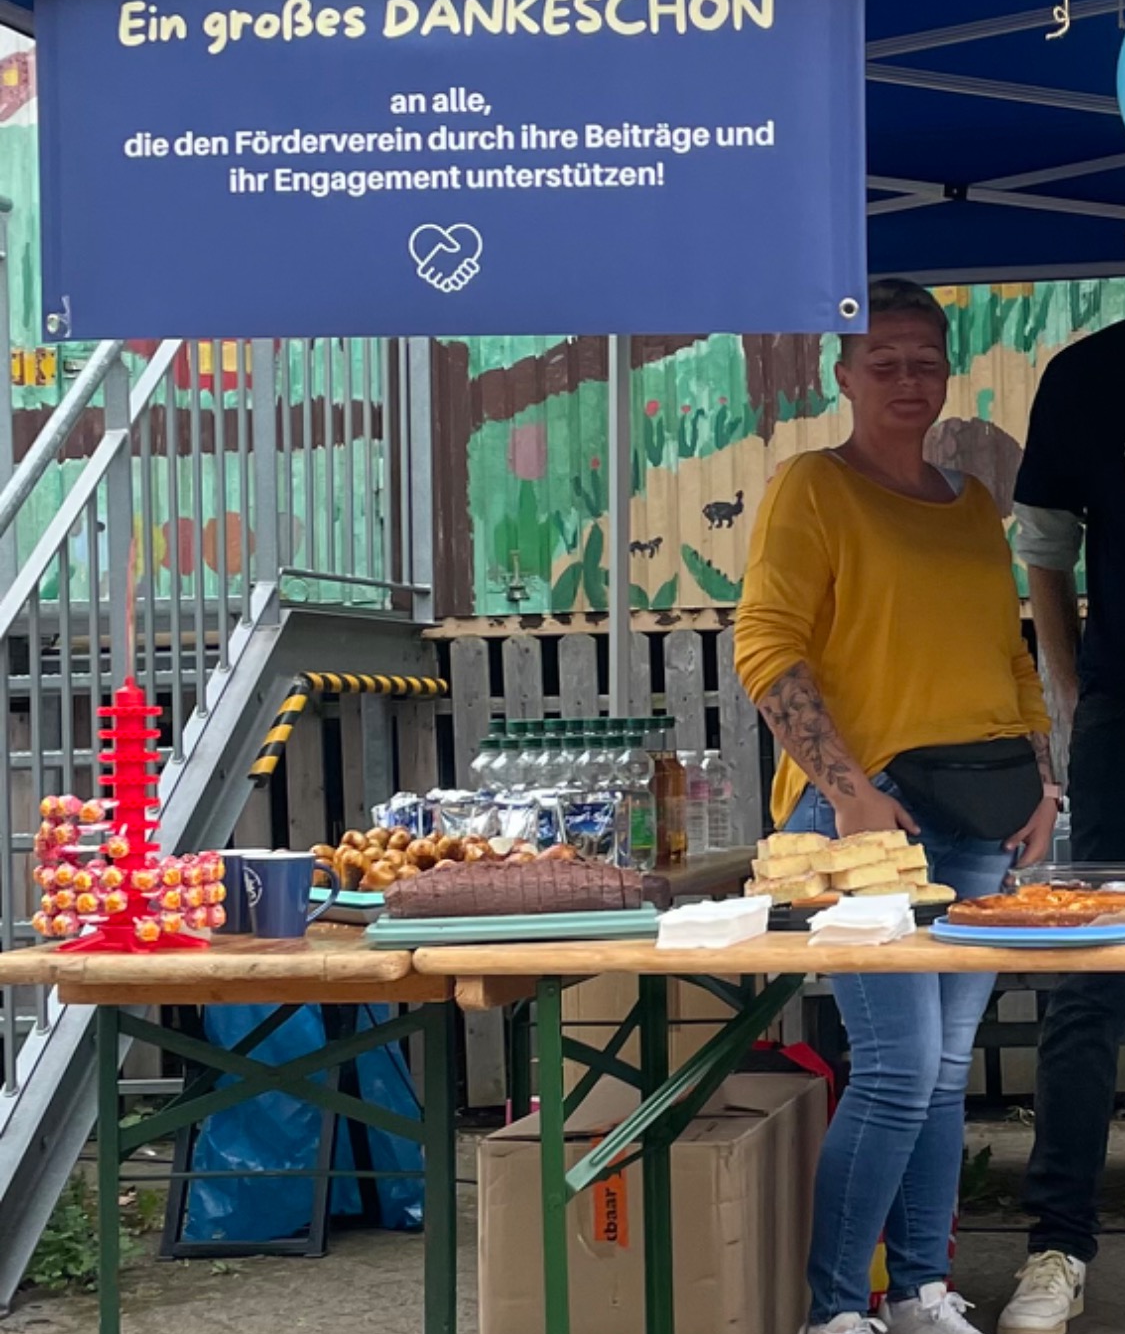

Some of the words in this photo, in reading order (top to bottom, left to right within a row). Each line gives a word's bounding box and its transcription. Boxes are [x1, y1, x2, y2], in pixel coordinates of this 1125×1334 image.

[118, 0, 187, 47] Ein
[390, 92, 426, 114] an
[432, 87, 492, 116] alle,
[124, 132, 169, 157] die
[174, 131, 229, 155] den
[235, 126, 422, 155] Förderverein
[428, 124, 514, 152] durch
[521, 123, 578, 149] ihre
[585, 122, 710, 154] Beiträge
[716, 119, 775, 147] und
[229, 167, 269, 193] ihr
[275, 163, 461, 198] Engagement
[466, 161, 665, 189] unterstützen!
